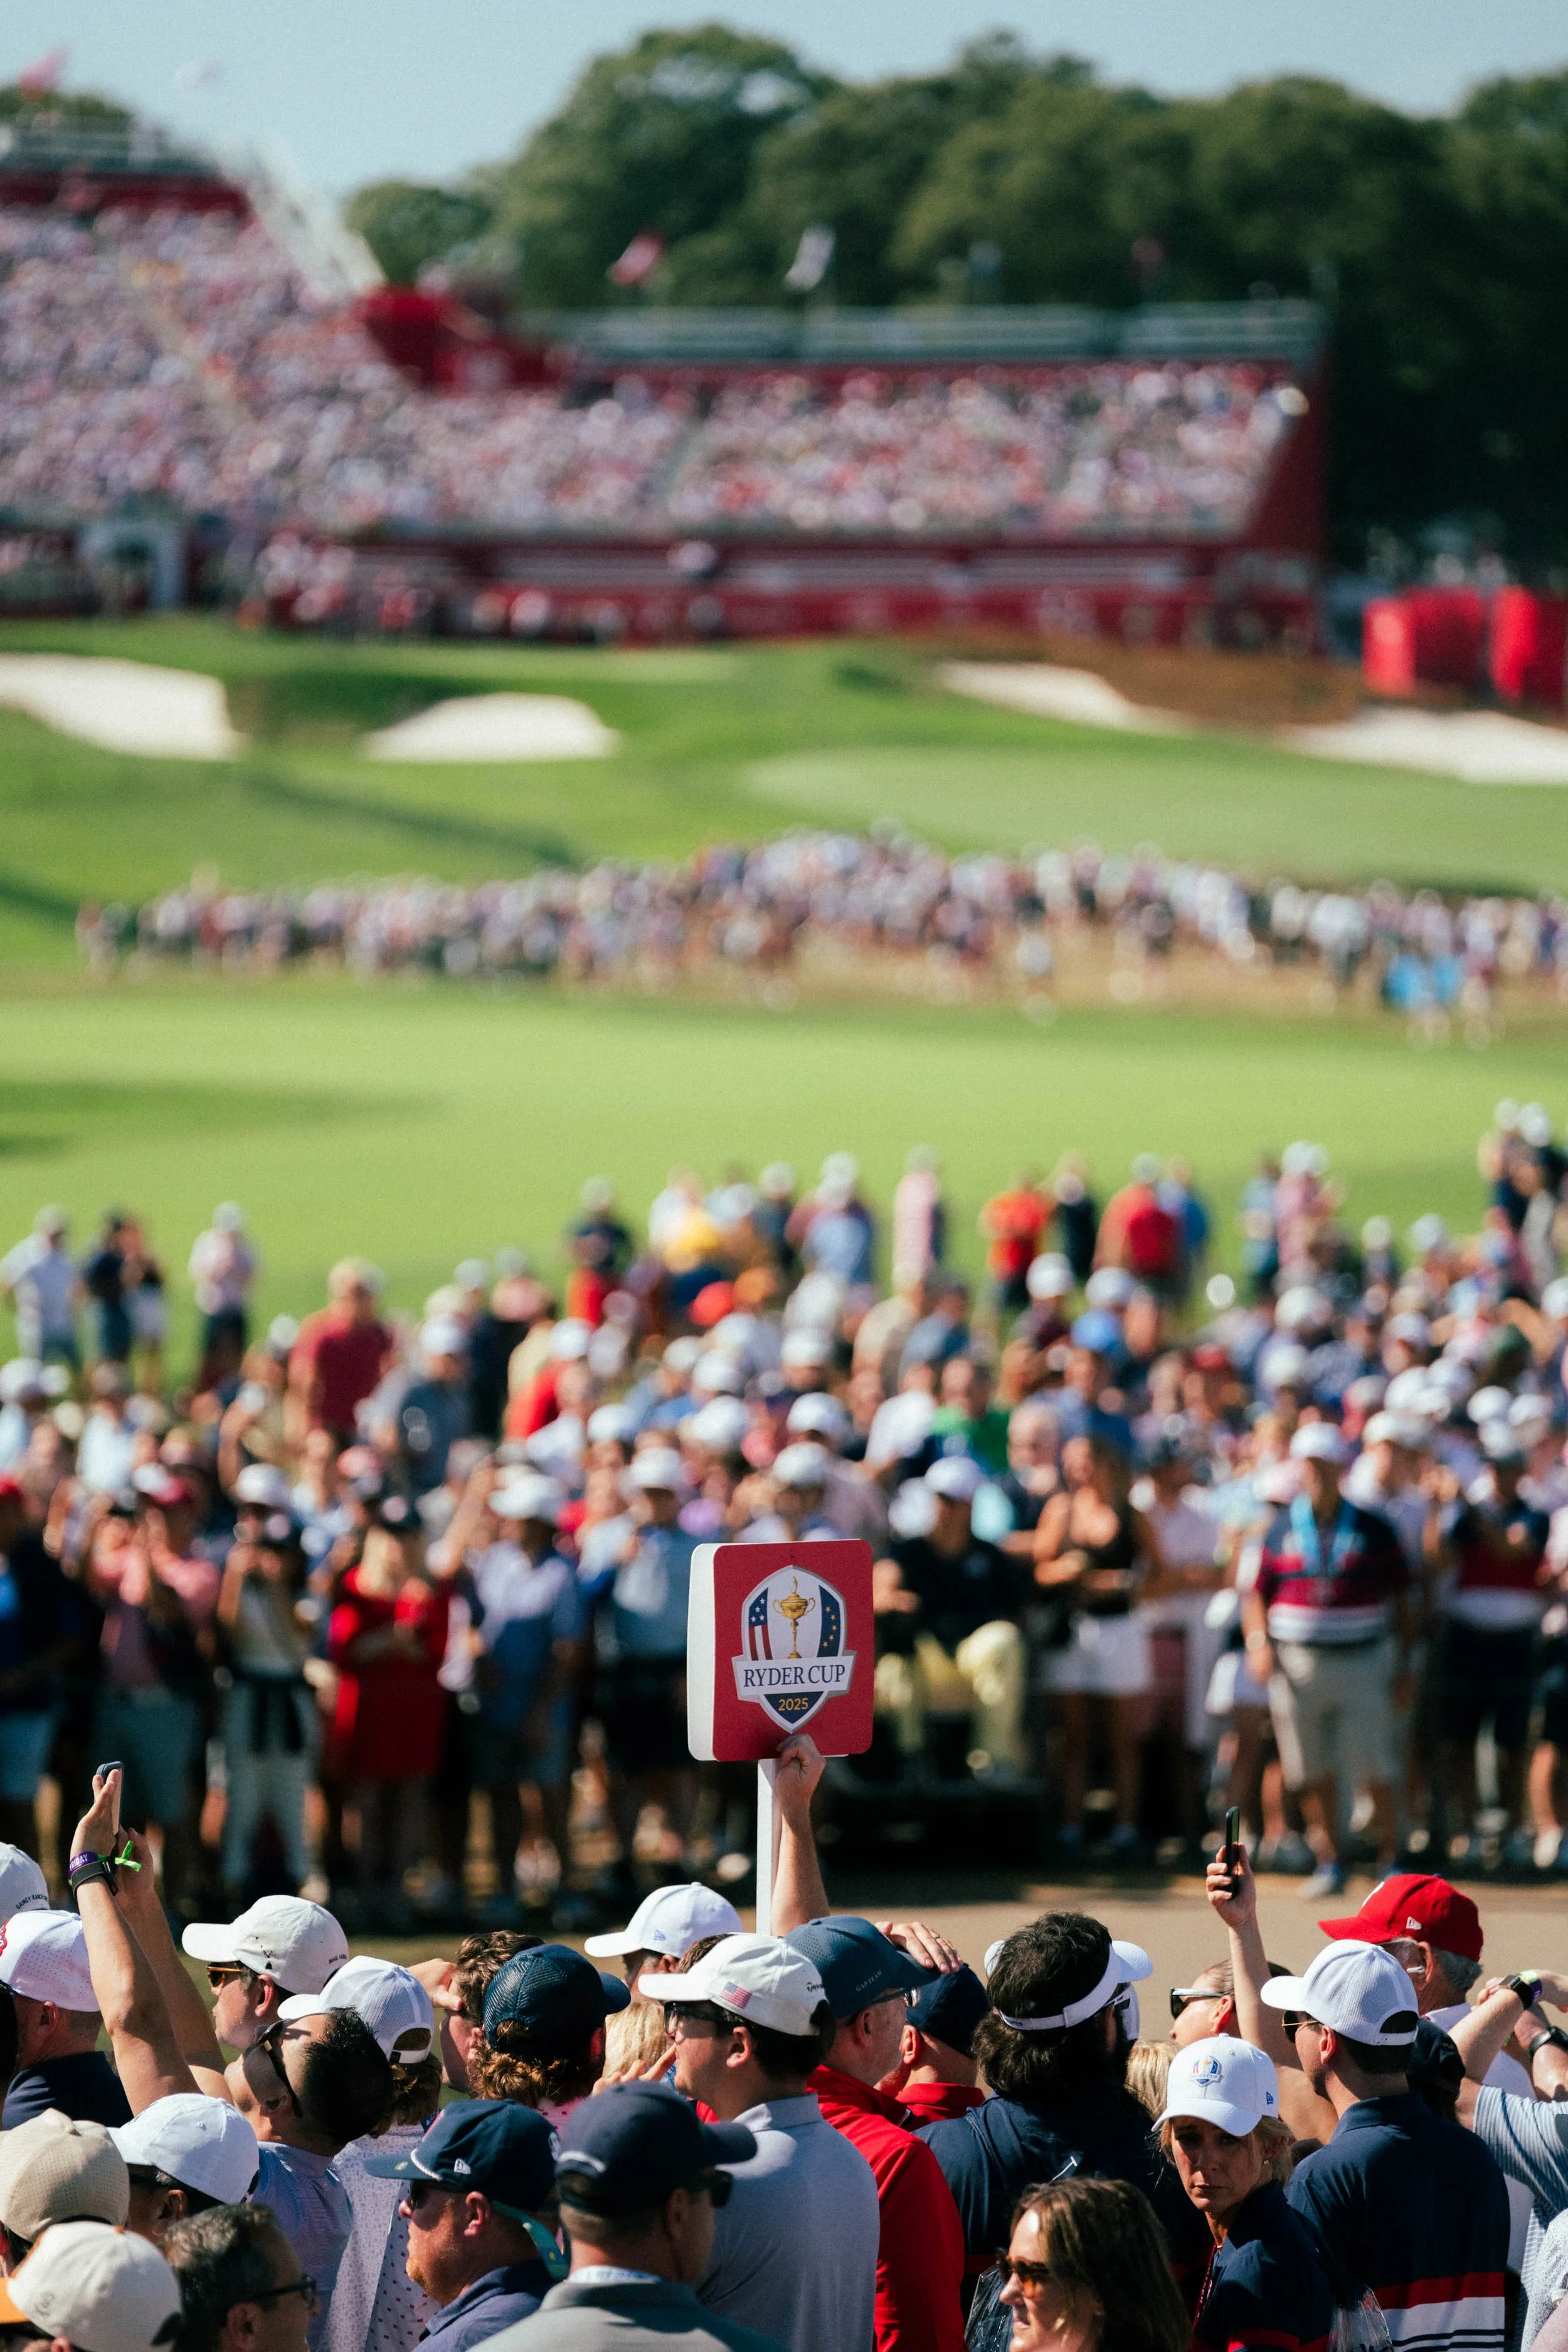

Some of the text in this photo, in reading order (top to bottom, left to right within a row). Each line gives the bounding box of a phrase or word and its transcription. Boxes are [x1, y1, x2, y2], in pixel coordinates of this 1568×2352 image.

[743, 1665, 845, 1687] RYDER CUP
[778, 1697, 808, 1711] 2025
[69, 1854, 88, 1871] FRIDAY
